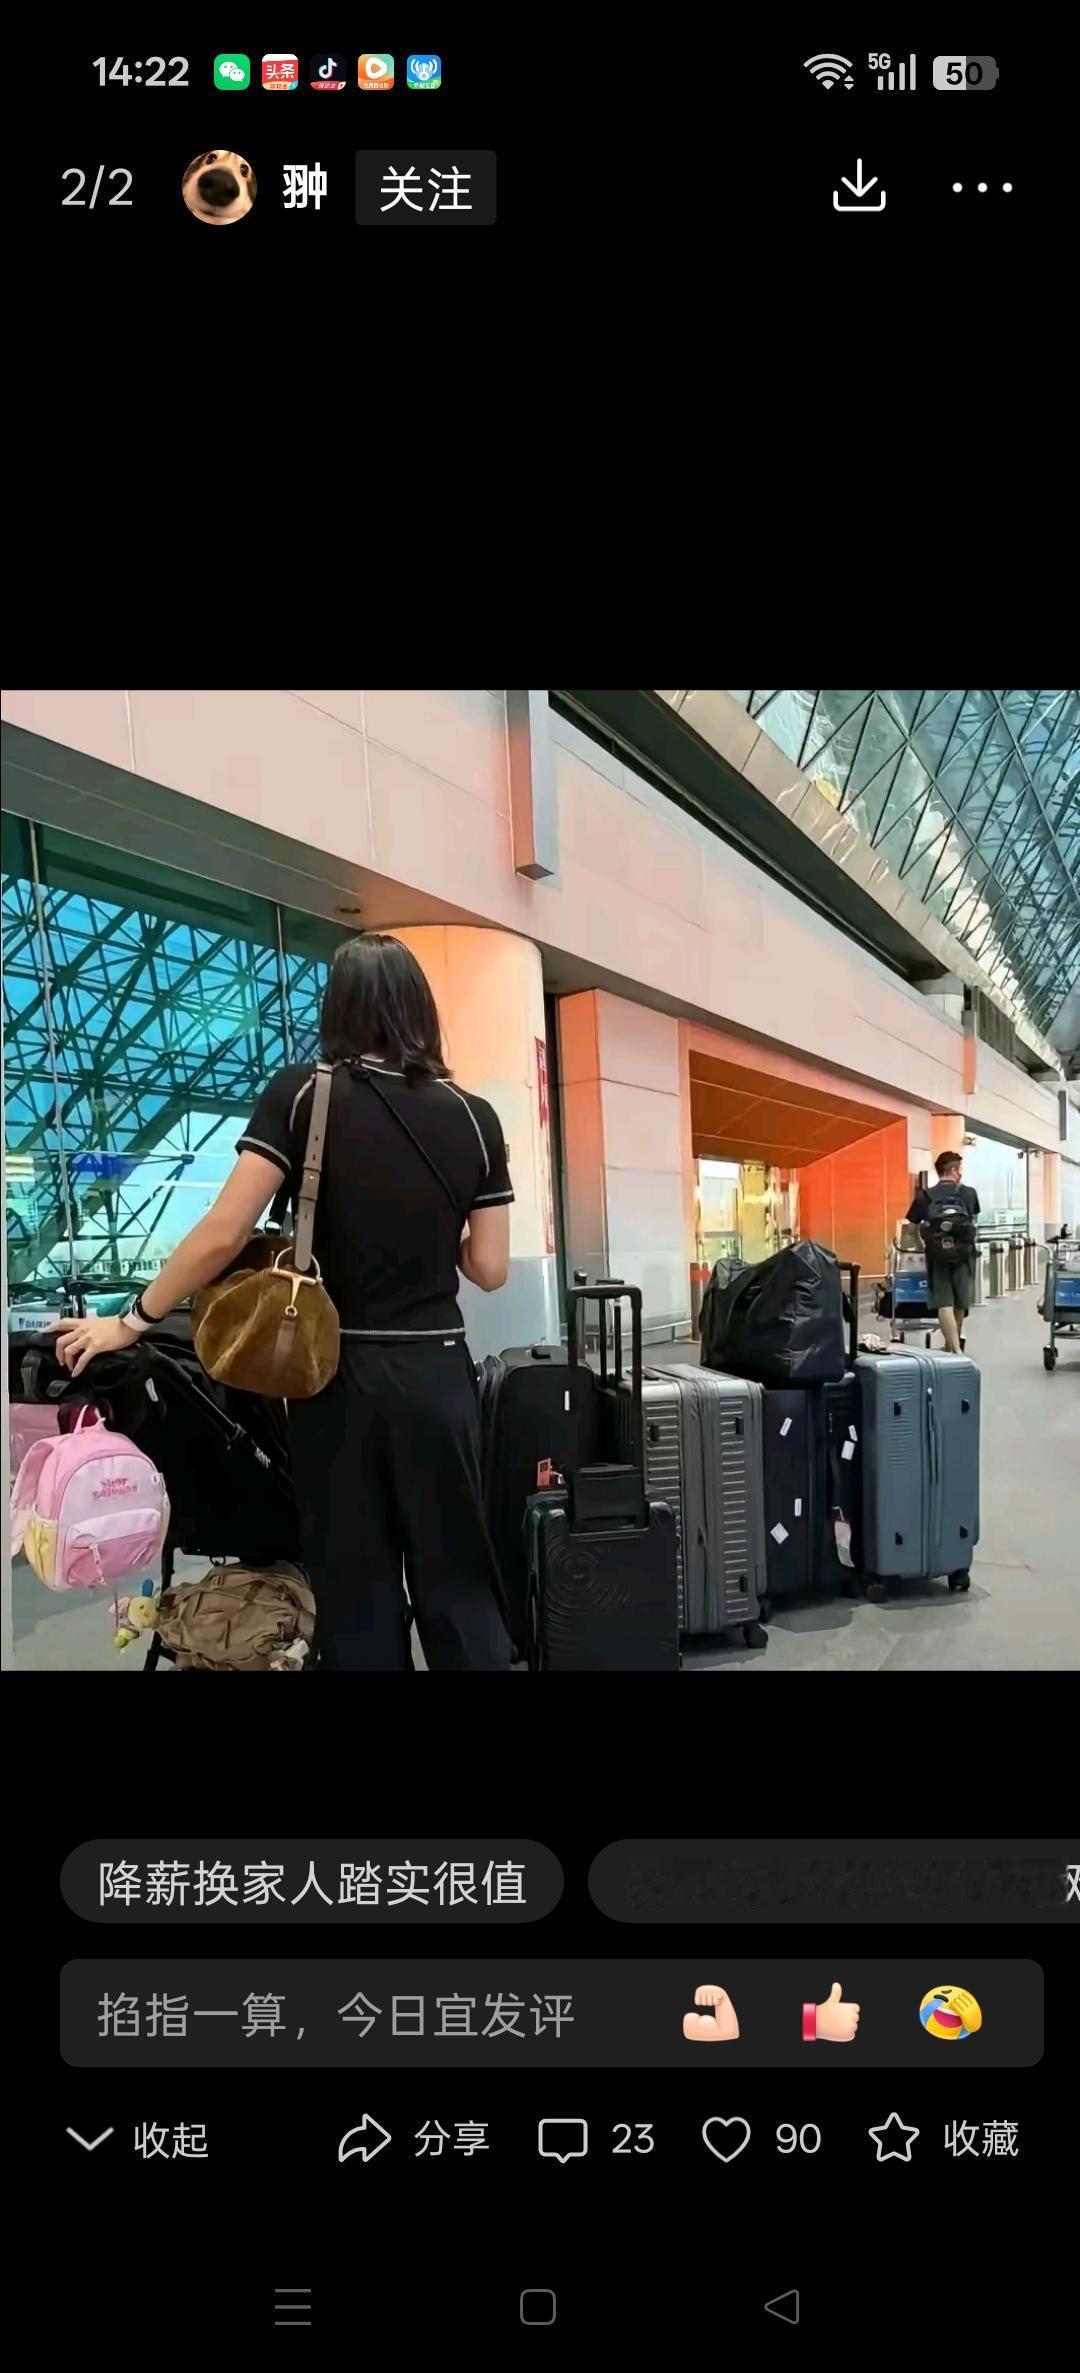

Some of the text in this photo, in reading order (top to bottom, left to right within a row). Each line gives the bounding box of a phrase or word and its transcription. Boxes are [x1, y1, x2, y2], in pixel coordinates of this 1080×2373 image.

[92, 56, 189, 87] 14:22
[265, 63, 295, 80] 头条
[868, 53, 891, 70] 5G
[946, 62, 983, 86] 50
[61, 165, 133, 210] 2/2
[282, 162, 328, 211] 翀
[380, 165, 473, 213] 关注
[98, 1860, 528, 1907] 降薪换家人踏实很值
[134, 2121, 209, 2159] 收起
[414, 2119, 490, 2157] 分享
[612, 2123, 655, 2154] 23
[775, 2123, 822, 2154] 90
[944, 2119, 1020, 2158] 收藏
